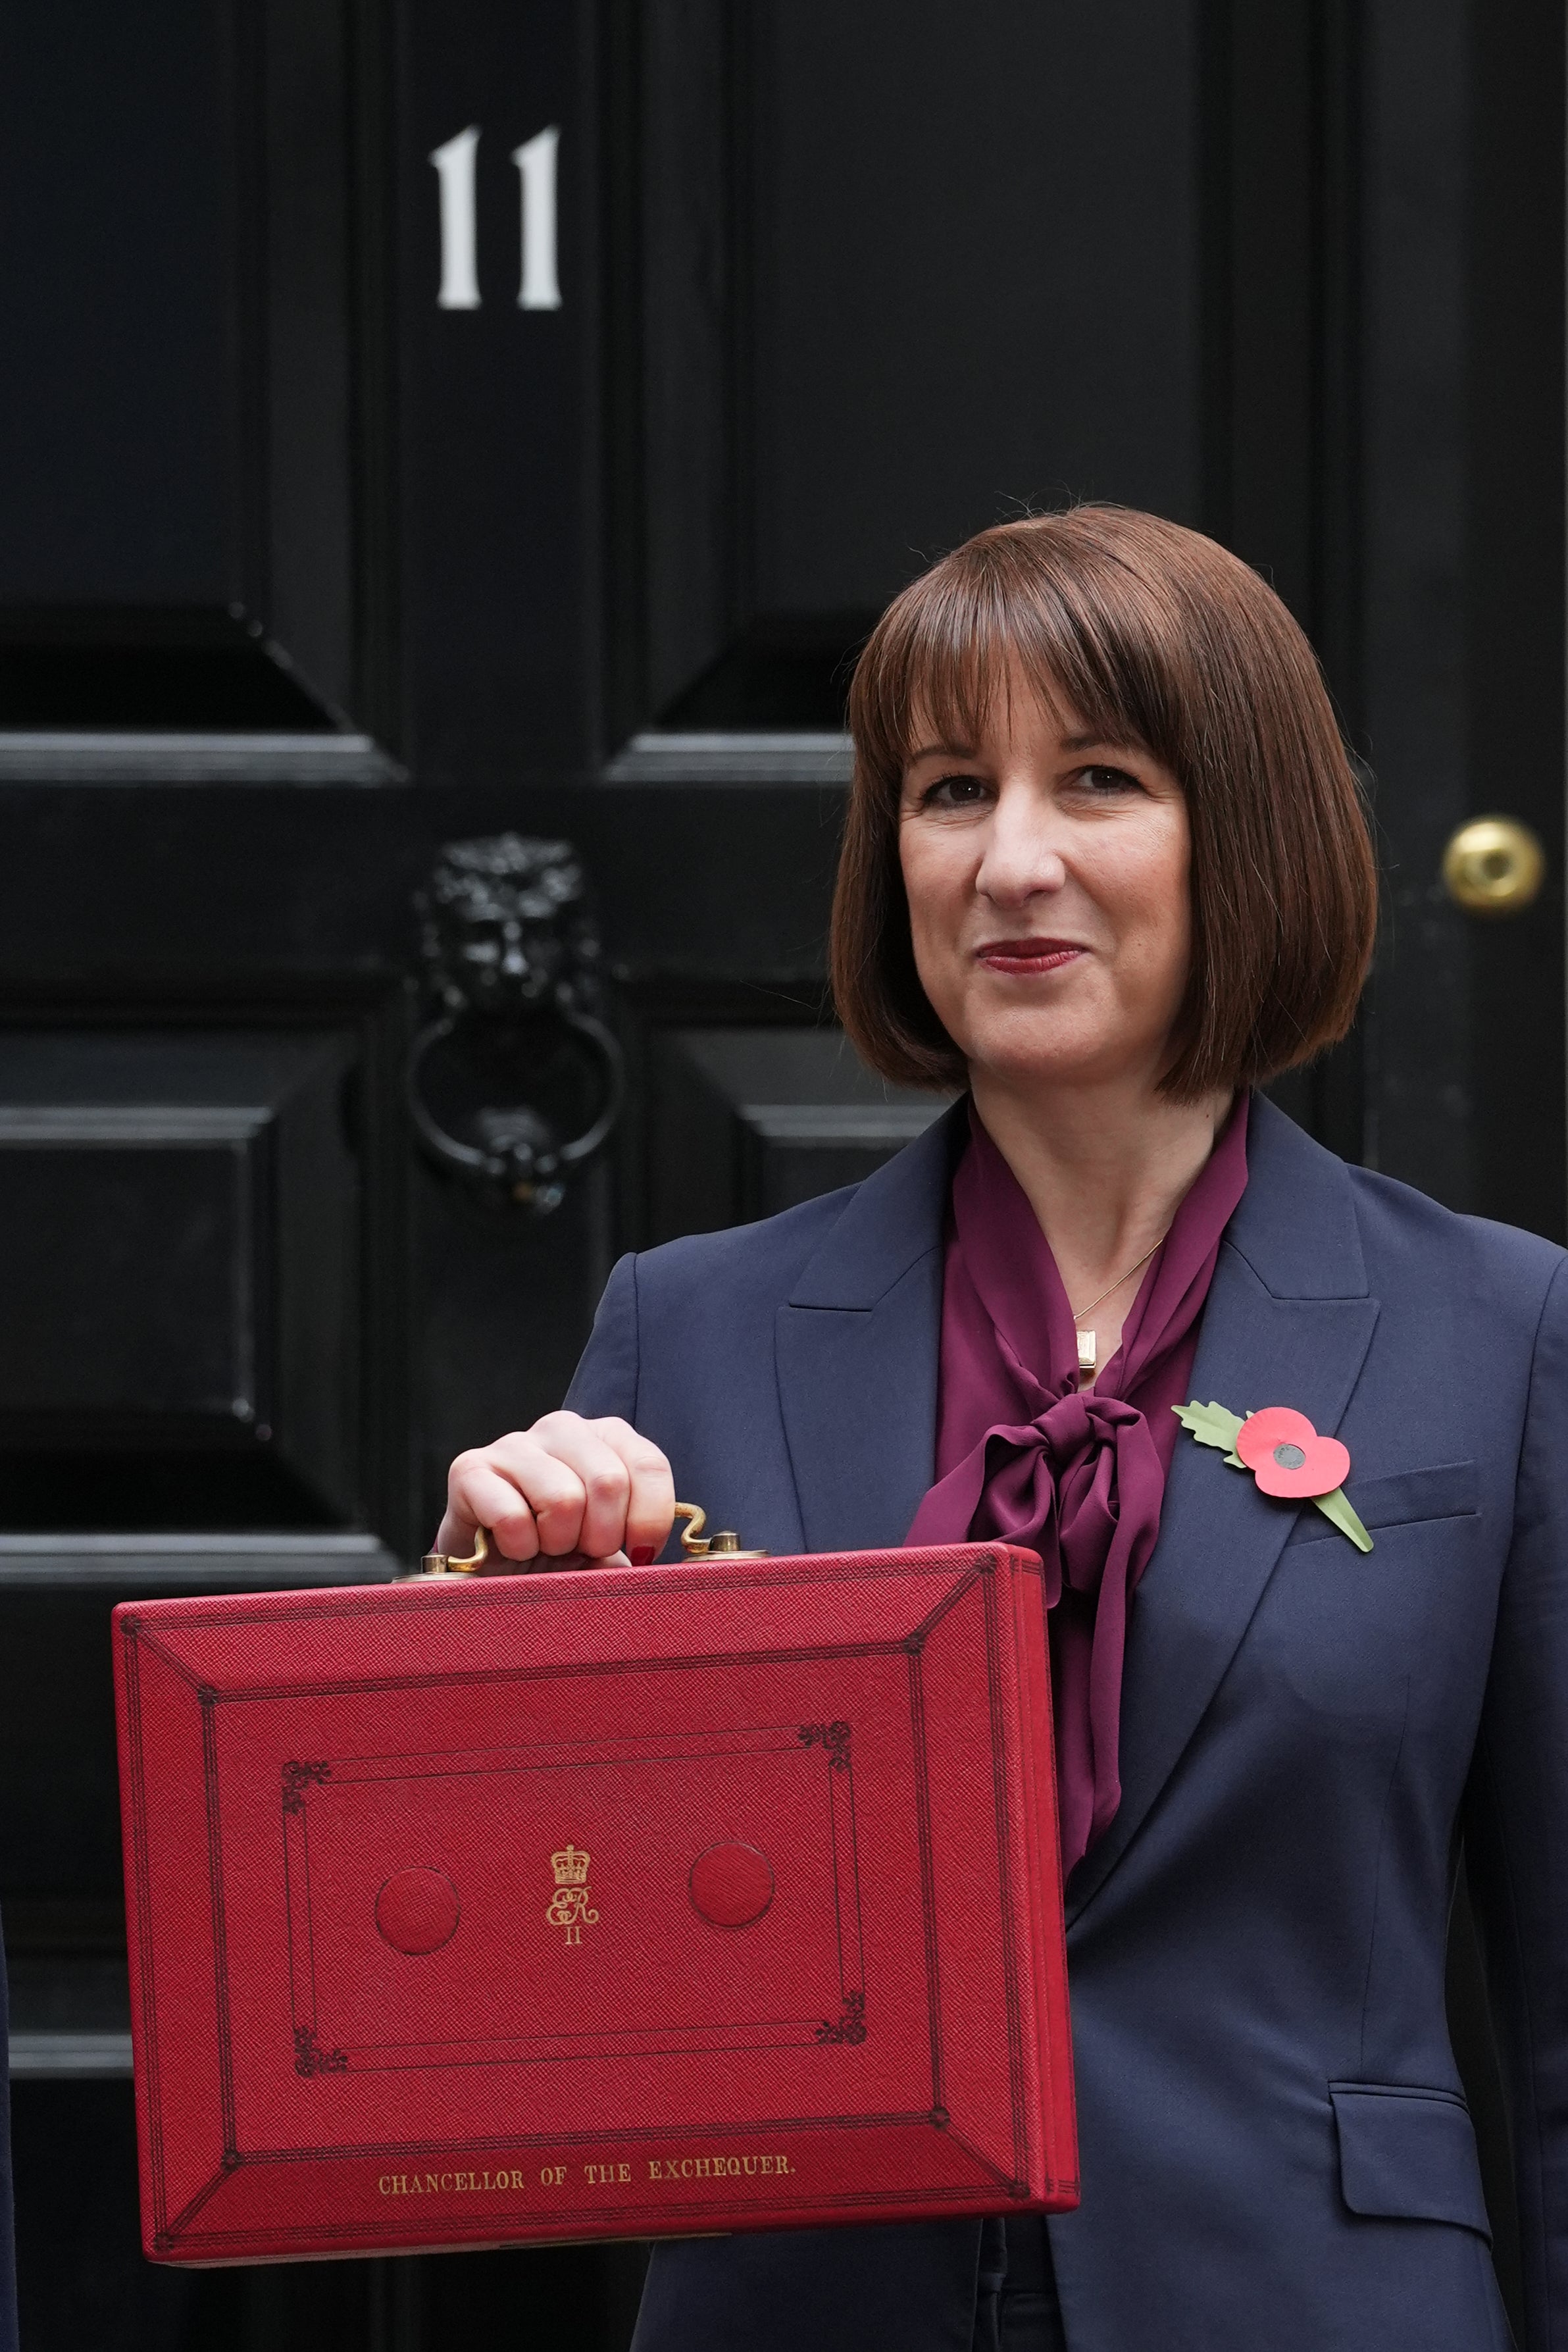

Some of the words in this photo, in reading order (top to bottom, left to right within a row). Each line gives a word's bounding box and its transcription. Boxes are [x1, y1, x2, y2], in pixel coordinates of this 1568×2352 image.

[429, 124, 562, 311] 11
[545, 1886, 599, 1926] ER
[564, 1926, 583, 1945] II
[378, 2170, 525, 2195] CHANCELLOR
[540, 2166, 567, 2186] OF
[584, 2162, 632, 2183] THE
[649, 2155, 796, 2179] EXCHEQUER.
